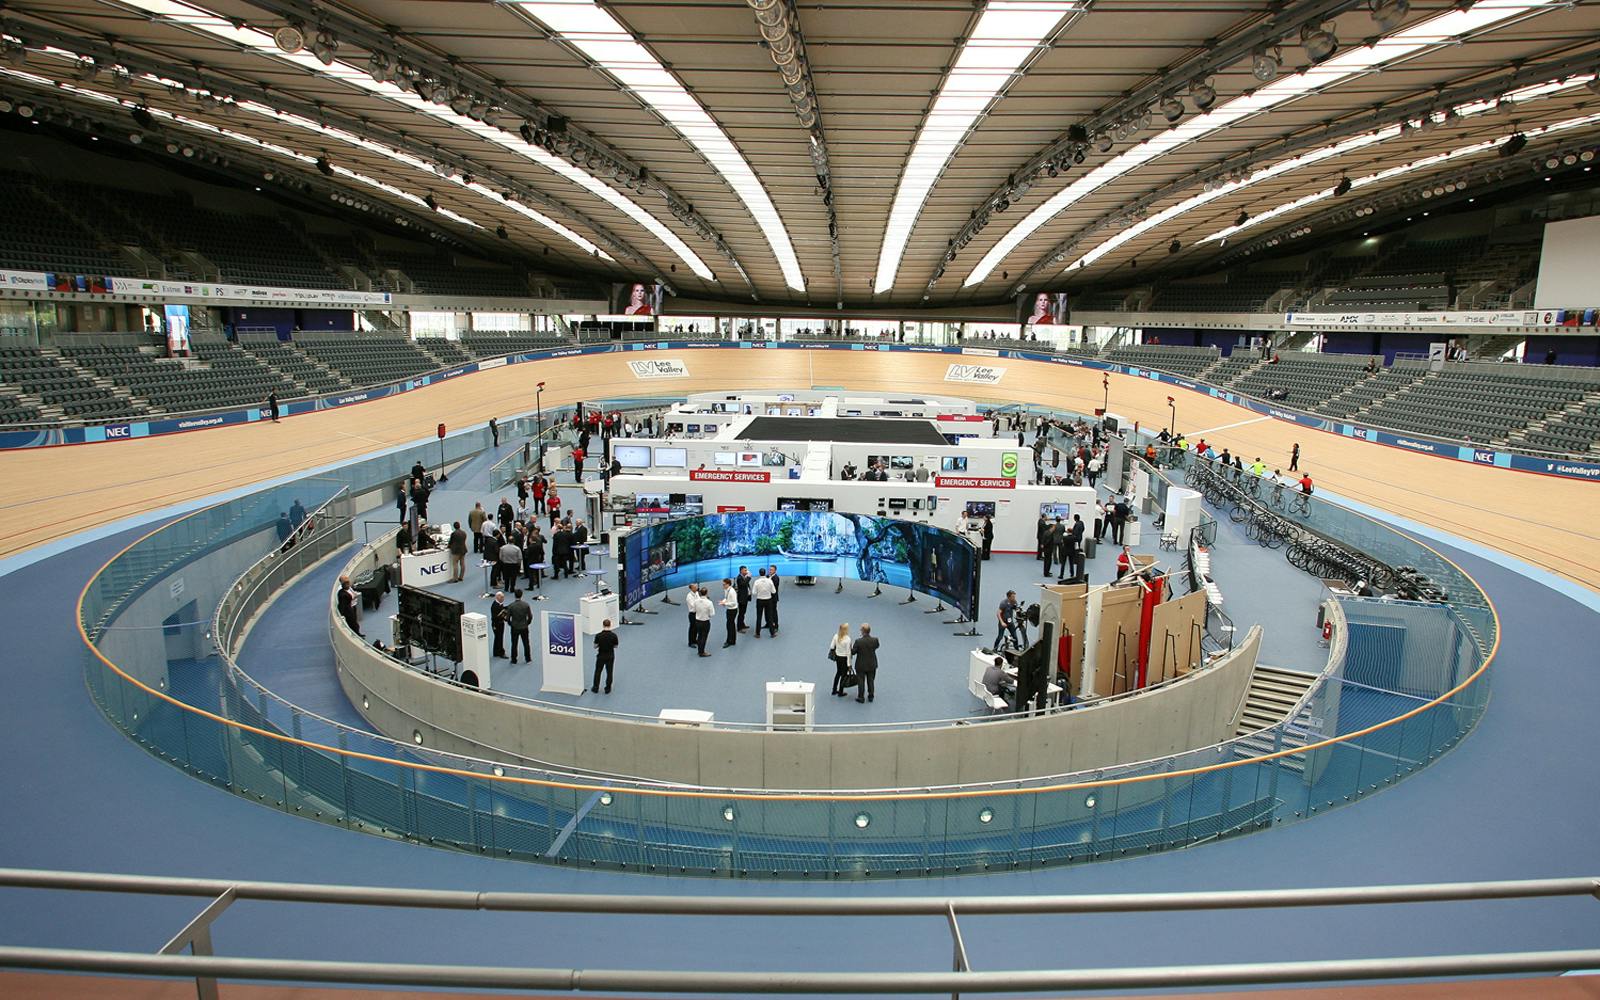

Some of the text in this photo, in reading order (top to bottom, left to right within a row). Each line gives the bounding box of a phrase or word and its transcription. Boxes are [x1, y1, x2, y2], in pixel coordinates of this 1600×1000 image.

[974, 372, 999, 381] Valley
[260, 410, 272, 418] NE
[107, 426, 129, 438] NEC
[1354, 430, 1366, 438] NEC
[1475, 452, 1494, 463] NEC
[1557, 464, 1600, 477] @LeeValleyVP
[695, 472, 765, 481] EMERGENCY SERVICES
[940, 479, 1011, 488] EMERGENCY SERVICES
[420, 562, 448, 576] NEC
[550, 645, 575, 654] 2014
